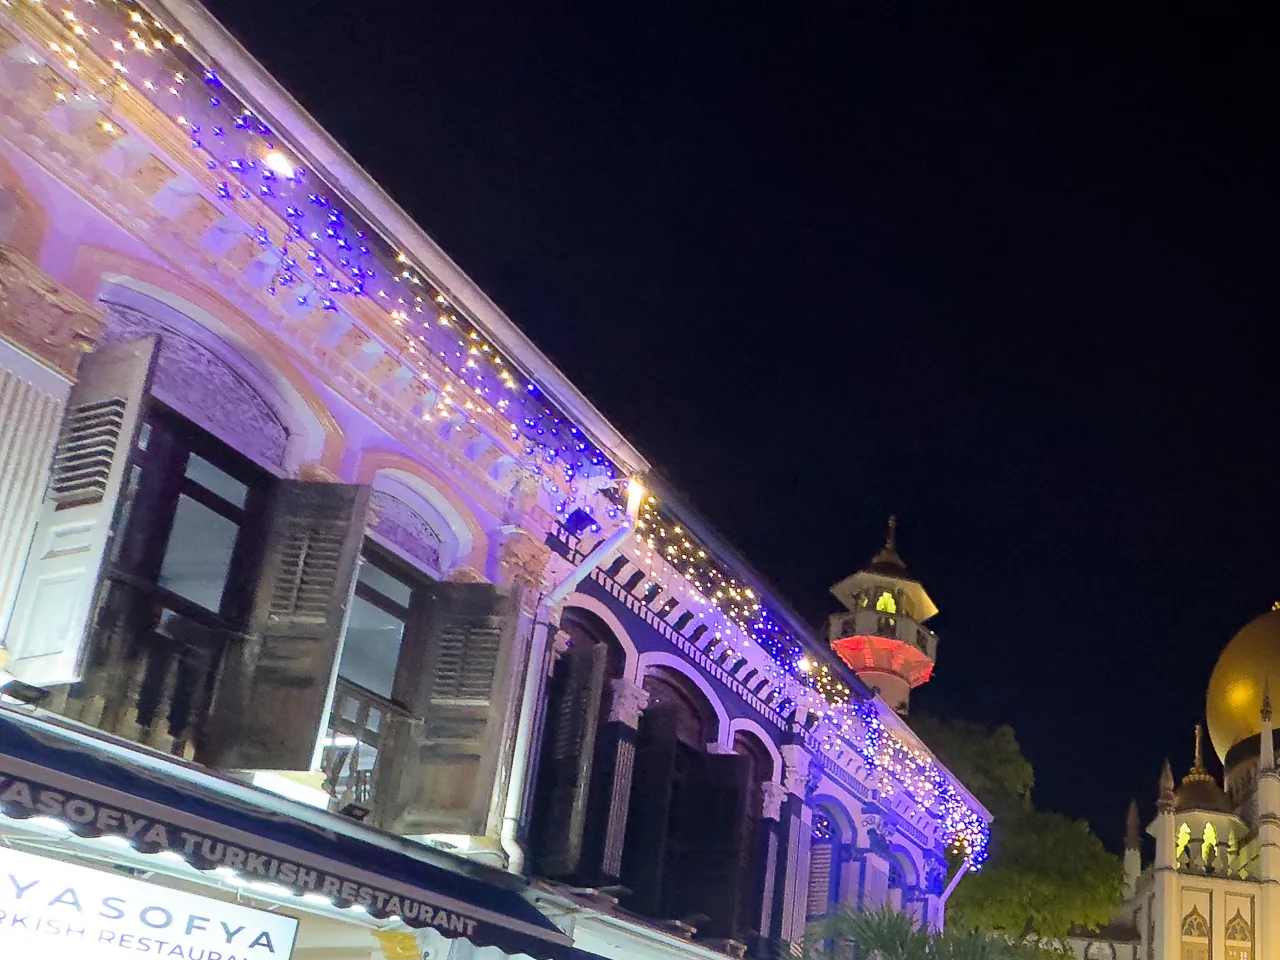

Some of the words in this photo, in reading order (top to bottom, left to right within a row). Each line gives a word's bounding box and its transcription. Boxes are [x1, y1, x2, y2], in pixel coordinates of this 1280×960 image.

[0, 777, 169, 848] ASOFYA
[180, 831, 317, 890] TURKISH
[321, 876, 478, 936] RESTAURANT
